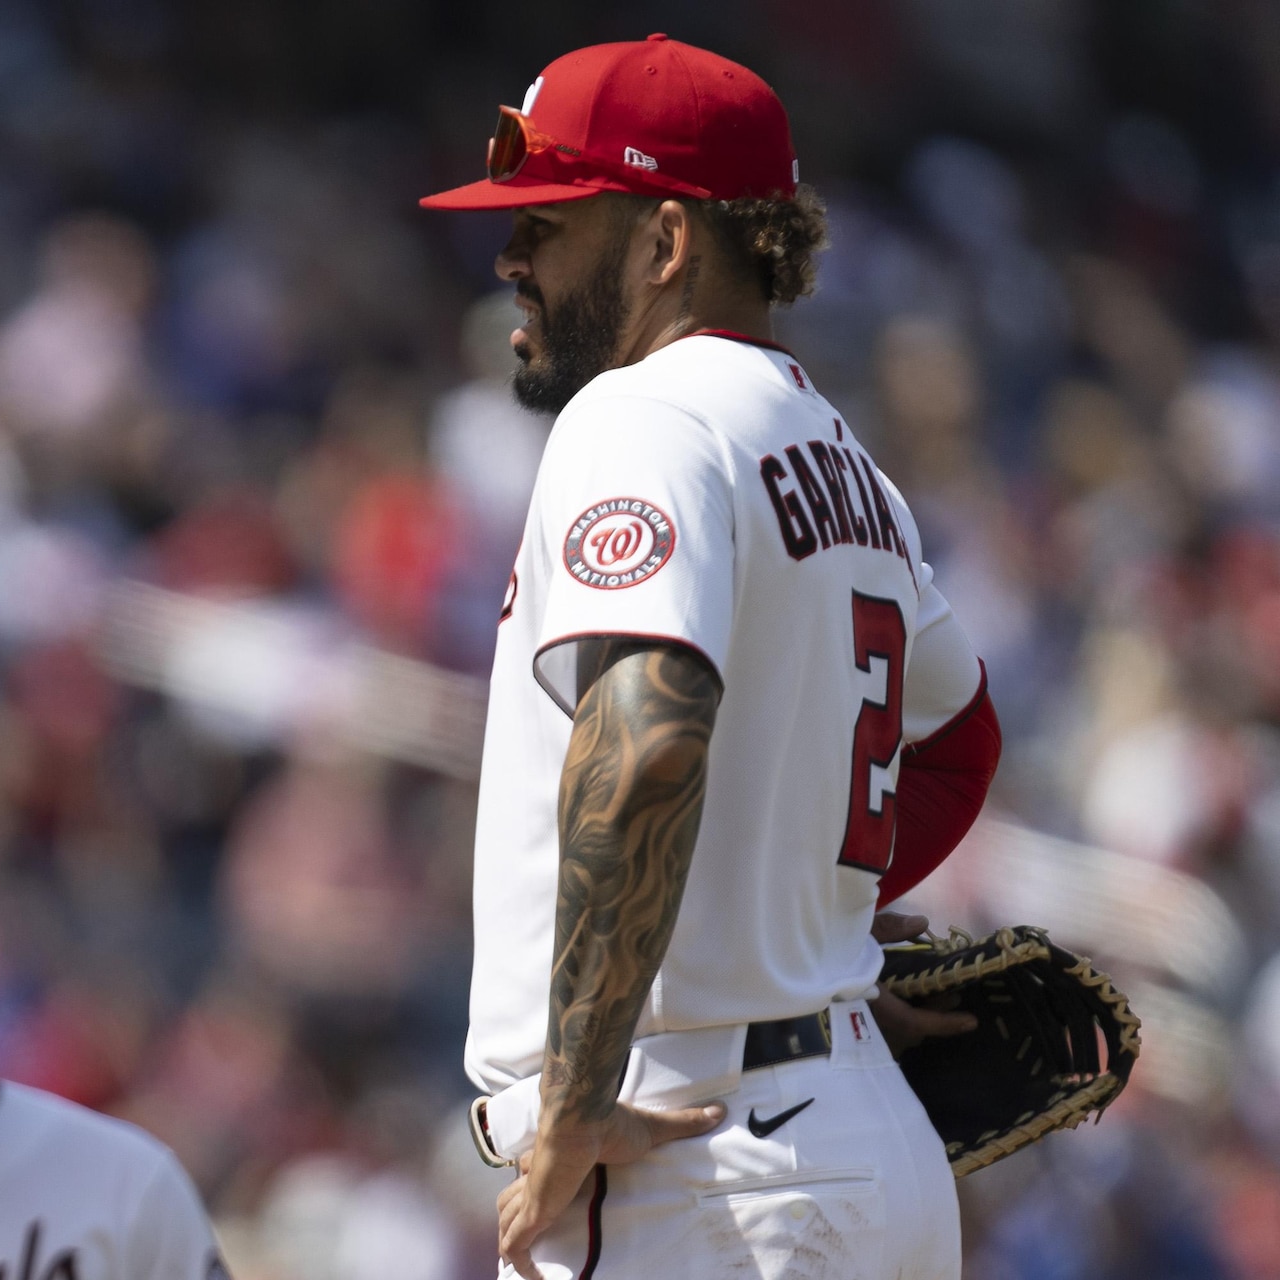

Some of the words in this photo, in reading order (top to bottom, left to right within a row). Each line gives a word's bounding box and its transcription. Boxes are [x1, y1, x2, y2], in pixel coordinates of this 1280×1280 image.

[568, 500, 669, 539] WASHINGTON
[760, 417, 905, 562] GARCÍA
[571, 554, 662, 586] NATIONALS
[837, 586, 908, 877] 2
